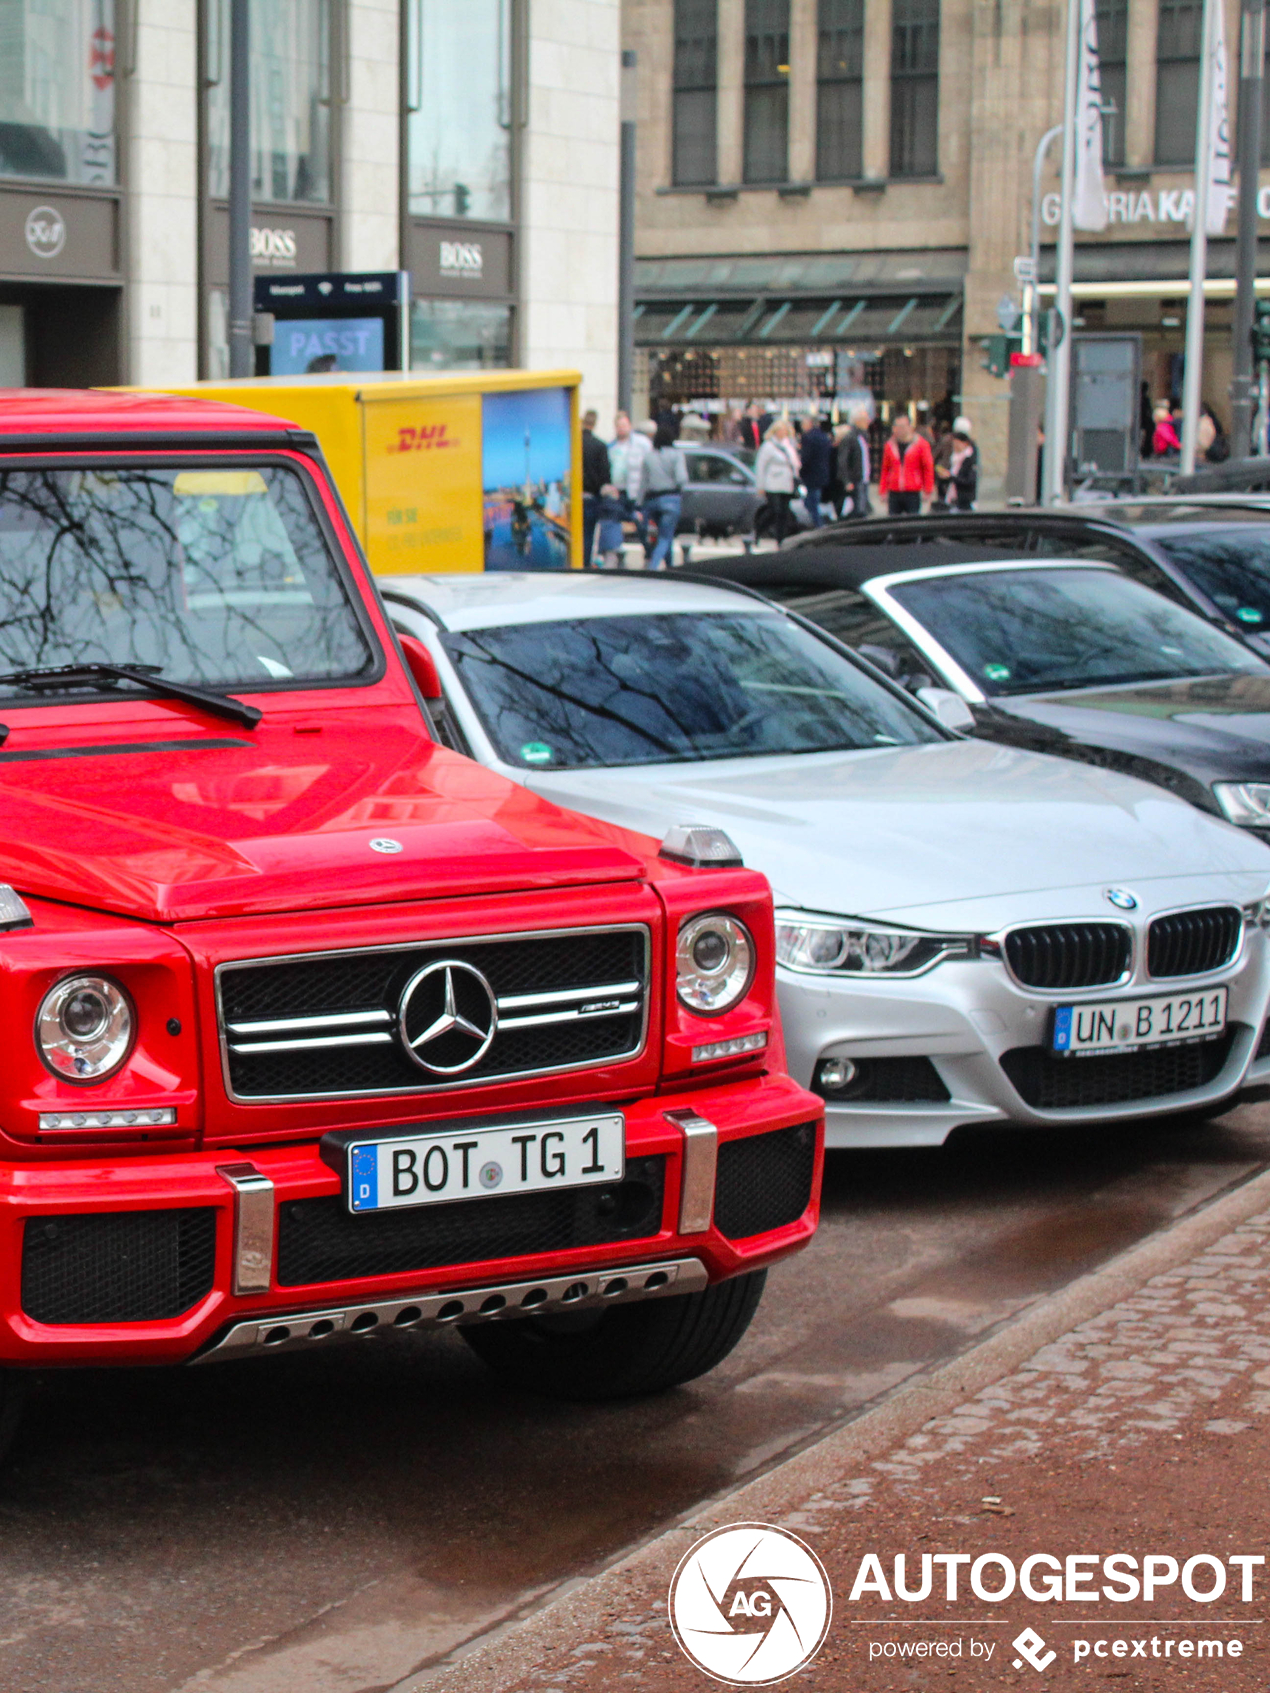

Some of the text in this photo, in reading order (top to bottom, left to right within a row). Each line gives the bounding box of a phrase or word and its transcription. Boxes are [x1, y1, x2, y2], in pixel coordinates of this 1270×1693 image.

[249, 227, 297, 258] BOSS
[439, 241, 483, 270] BOSS
[291, 331, 370, 356] PASST
[396, 424, 448, 451] DHL
[1076, 994, 1222, 1043] UN B 1211
[391, 1126, 606, 1197] BOT TG 1
[359, 1183, 371, 1199] D
